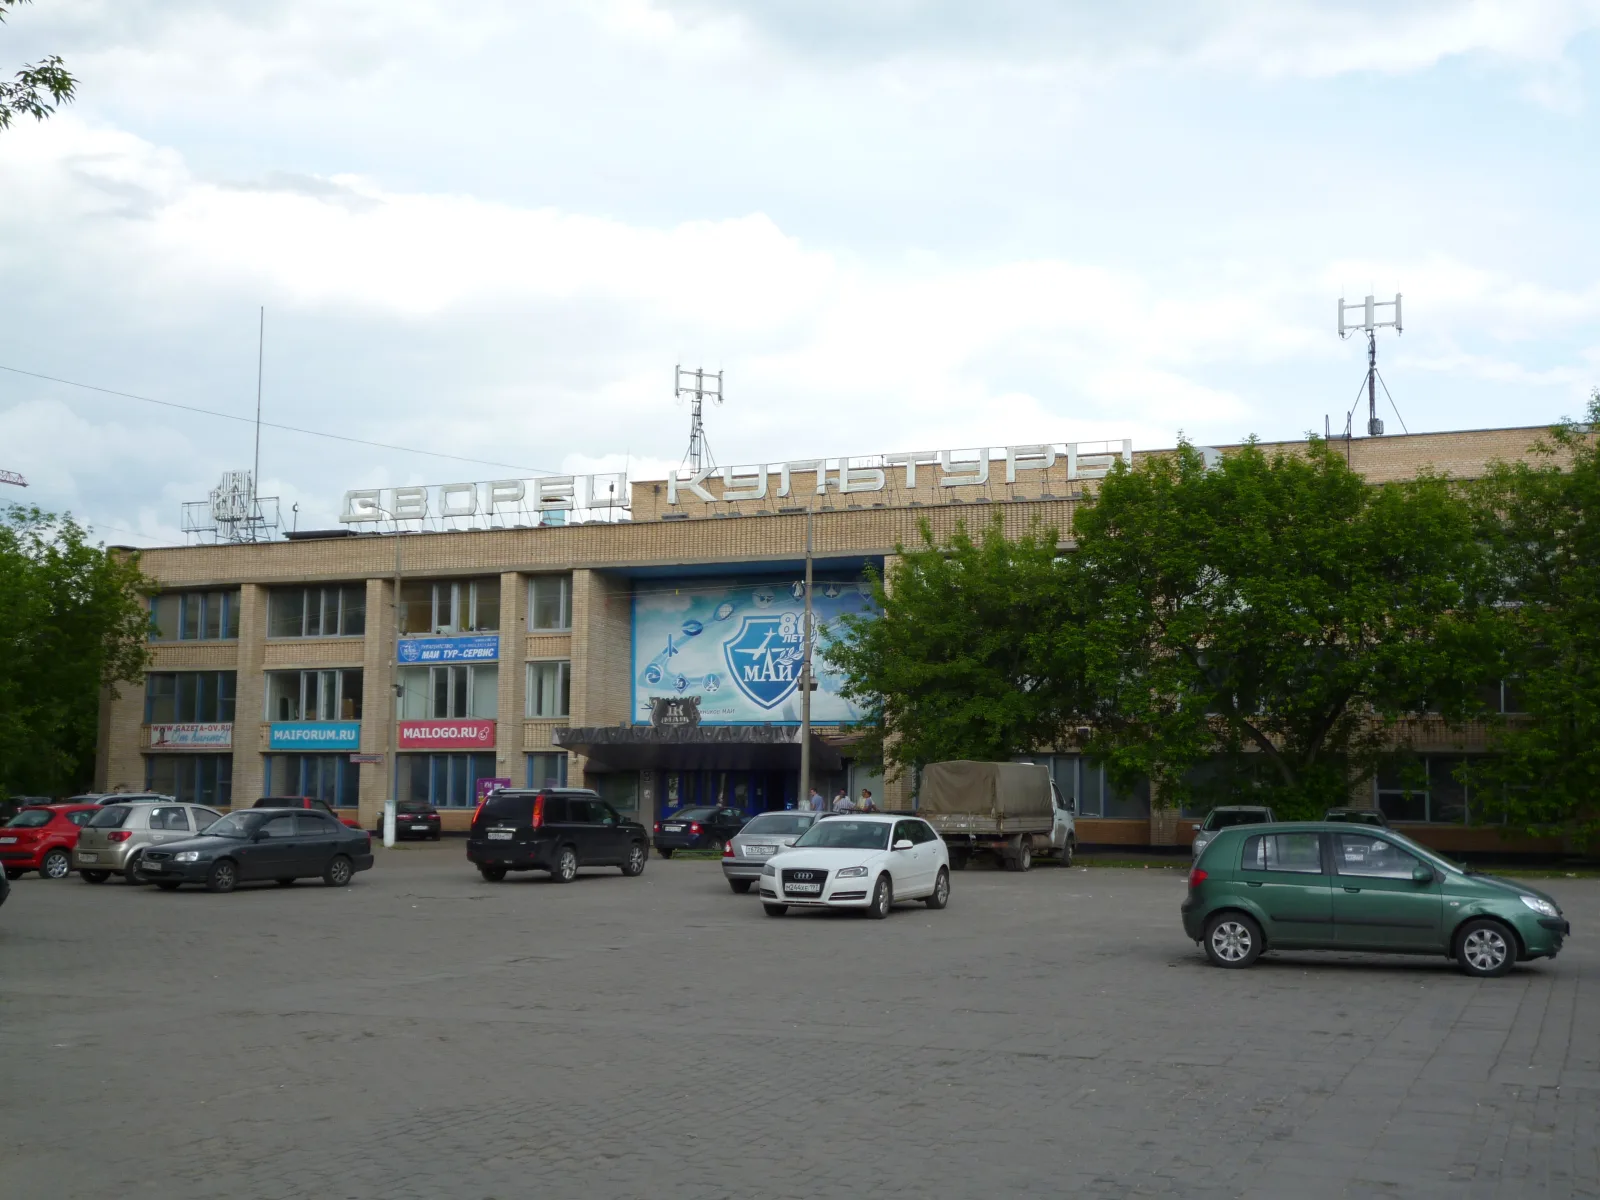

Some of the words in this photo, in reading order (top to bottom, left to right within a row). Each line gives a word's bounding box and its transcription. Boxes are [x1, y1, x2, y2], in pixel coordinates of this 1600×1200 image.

[339, 472, 629, 523] ДВОРЕЦ
[667, 438, 1132, 504] КУЛЬТУРЫ
[777, 612, 816, 636] 80
[782, 634, 805, 643] ЛЕТ
[421, 650, 440, 660] МАИ
[443, 648, 494, 659] ТУР-СЕРВИС
[743, 647, 793, 682] МАИ
[274, 729, 355, 740] MAIFORUM.RU
[403, 727, 477, 739] MAILOGO.RU
